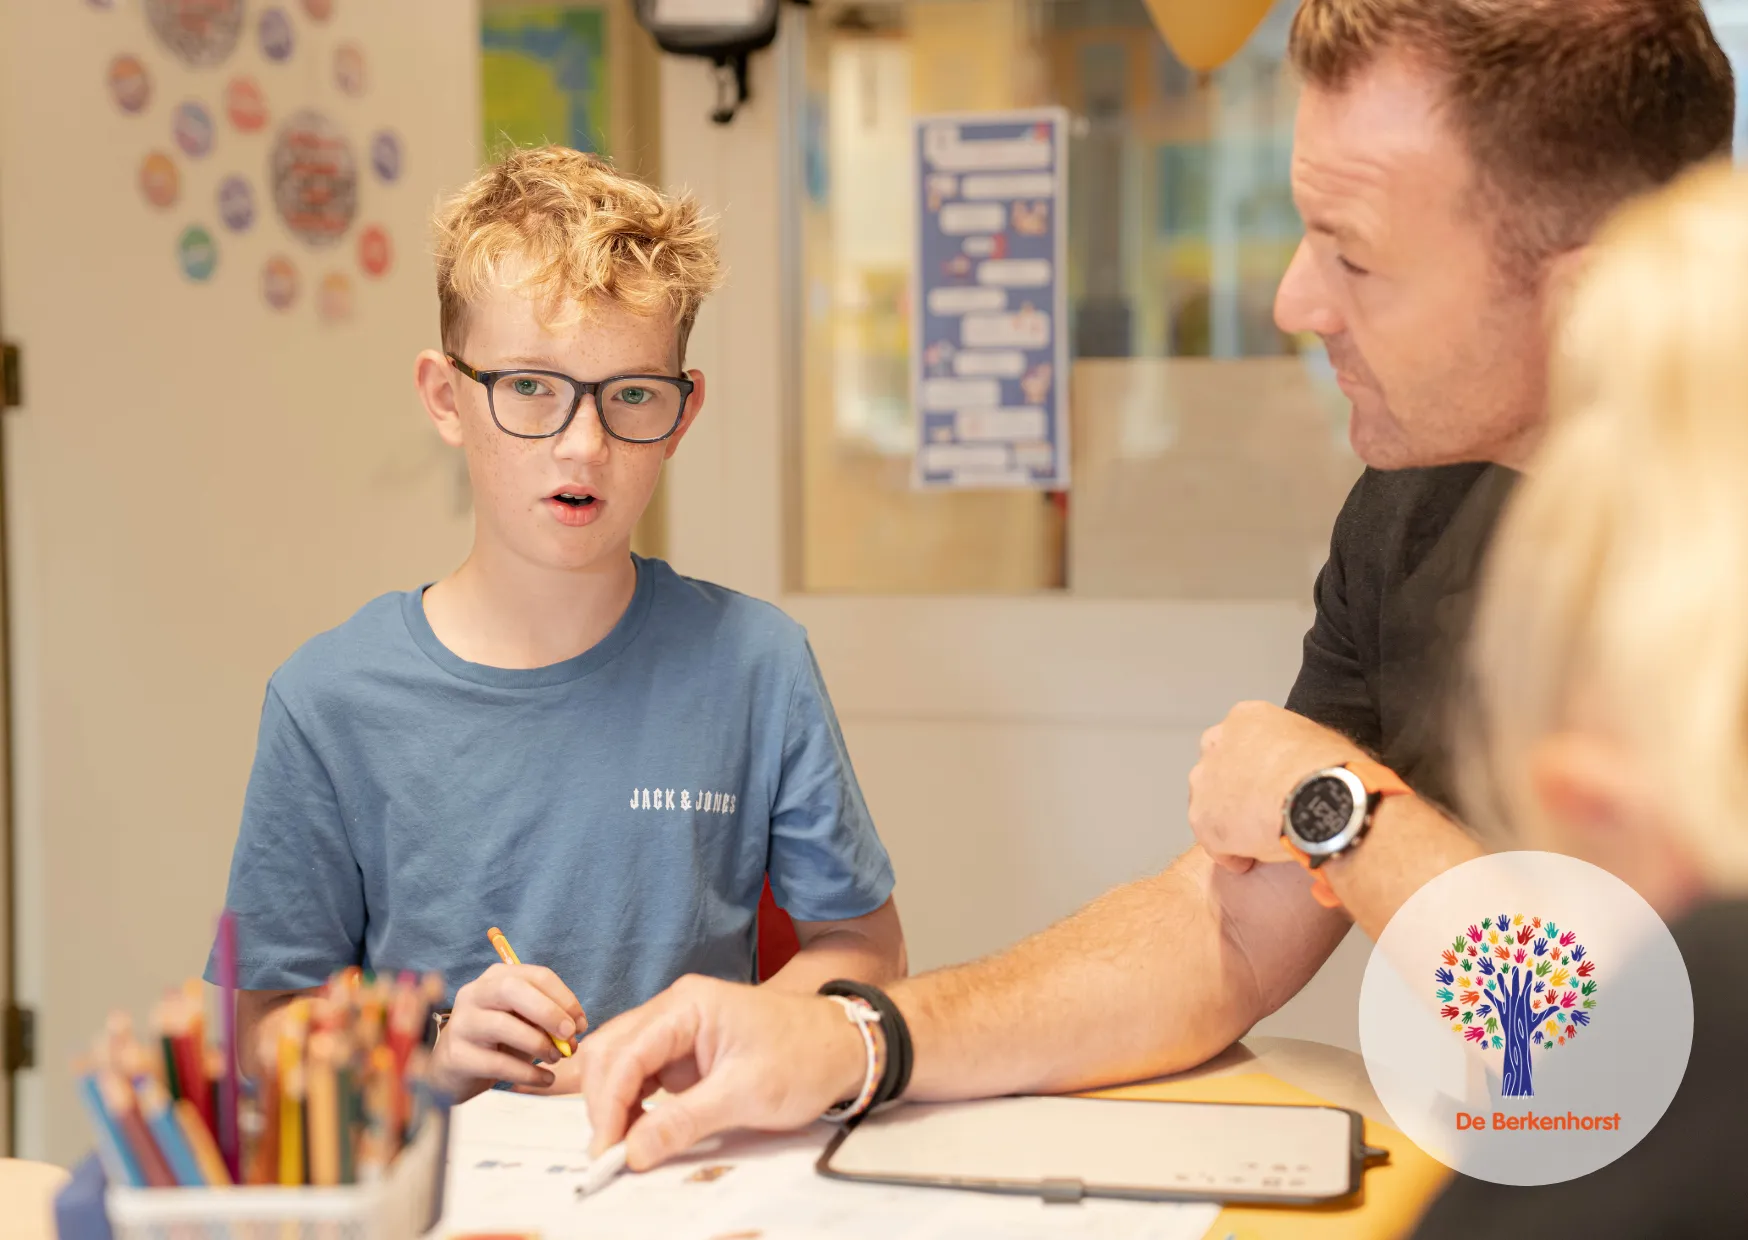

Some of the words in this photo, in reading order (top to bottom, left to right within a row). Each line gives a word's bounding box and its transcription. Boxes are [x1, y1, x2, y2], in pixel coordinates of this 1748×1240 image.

[630, 788, 675, 810] JACK
[680, 789, 692, 811] &
[695, 789, 736, 814] JONES
